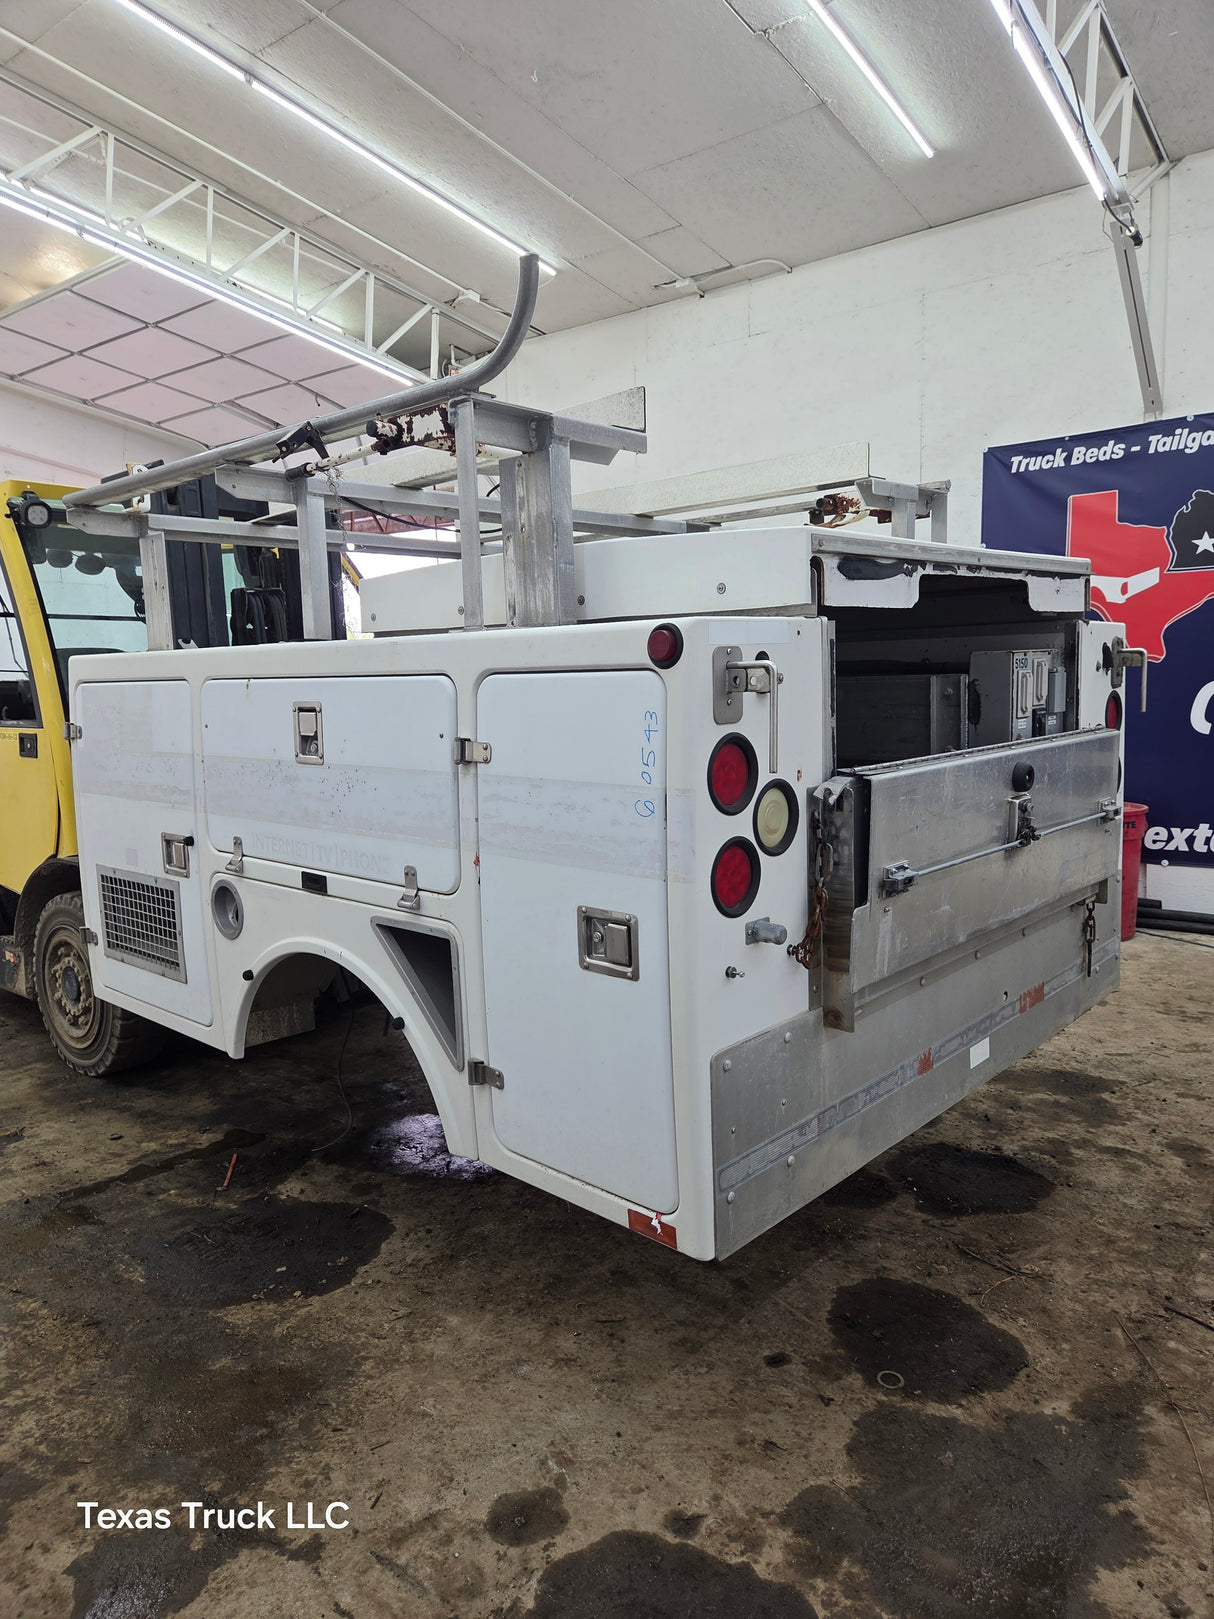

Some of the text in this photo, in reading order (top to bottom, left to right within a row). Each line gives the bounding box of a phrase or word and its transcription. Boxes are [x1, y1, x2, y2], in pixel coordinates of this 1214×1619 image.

[1010, 448, 1068, 474] Truck
[1070, 440, 1126, 466] Beds
[1144, 823, 1214, 853] ext
